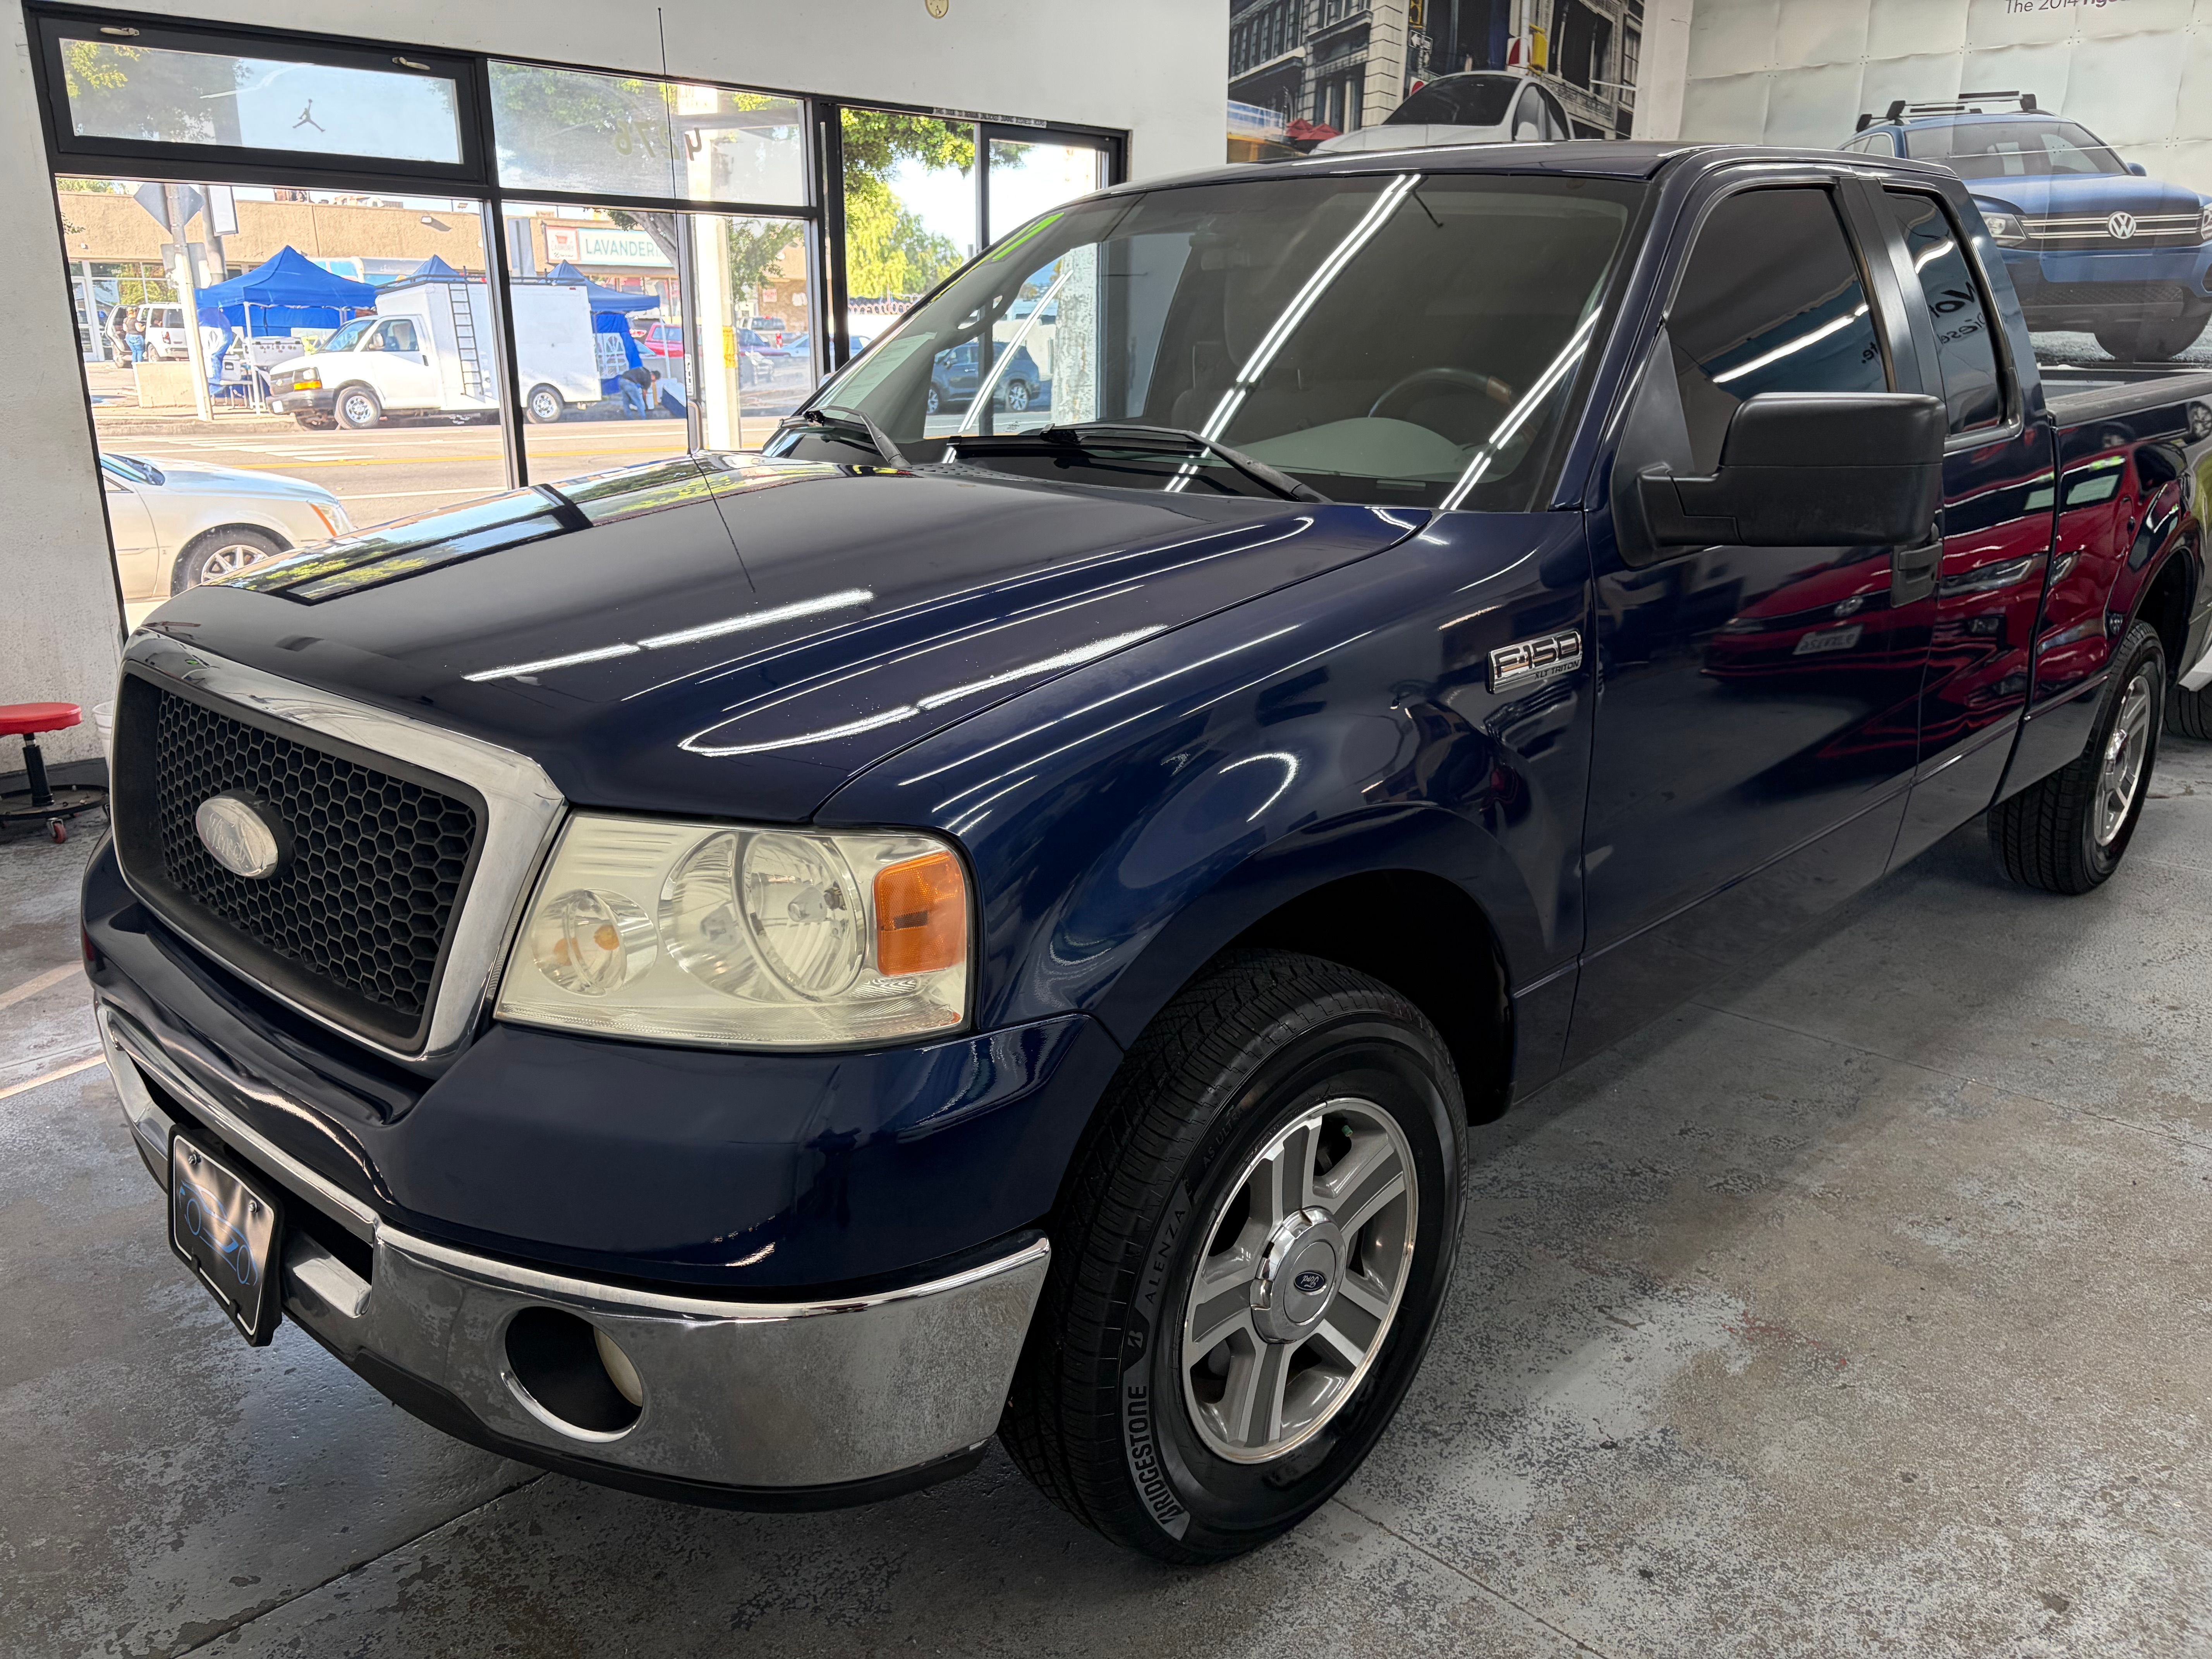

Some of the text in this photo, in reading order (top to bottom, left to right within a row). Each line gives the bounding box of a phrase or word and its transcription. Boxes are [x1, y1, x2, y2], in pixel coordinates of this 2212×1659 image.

[586, 238, 661, 257] LAVANDERI
[1534, 659, 1580, 680] XLT TRITON
[1203, 1146, 1215, 1168] AS
[1145, 1211, 1186, 1304] ALENZA
[1300, 1274, 1319, 1288] Ford
[1128, 1386, 1185, 1525] BRIDGESTONE
